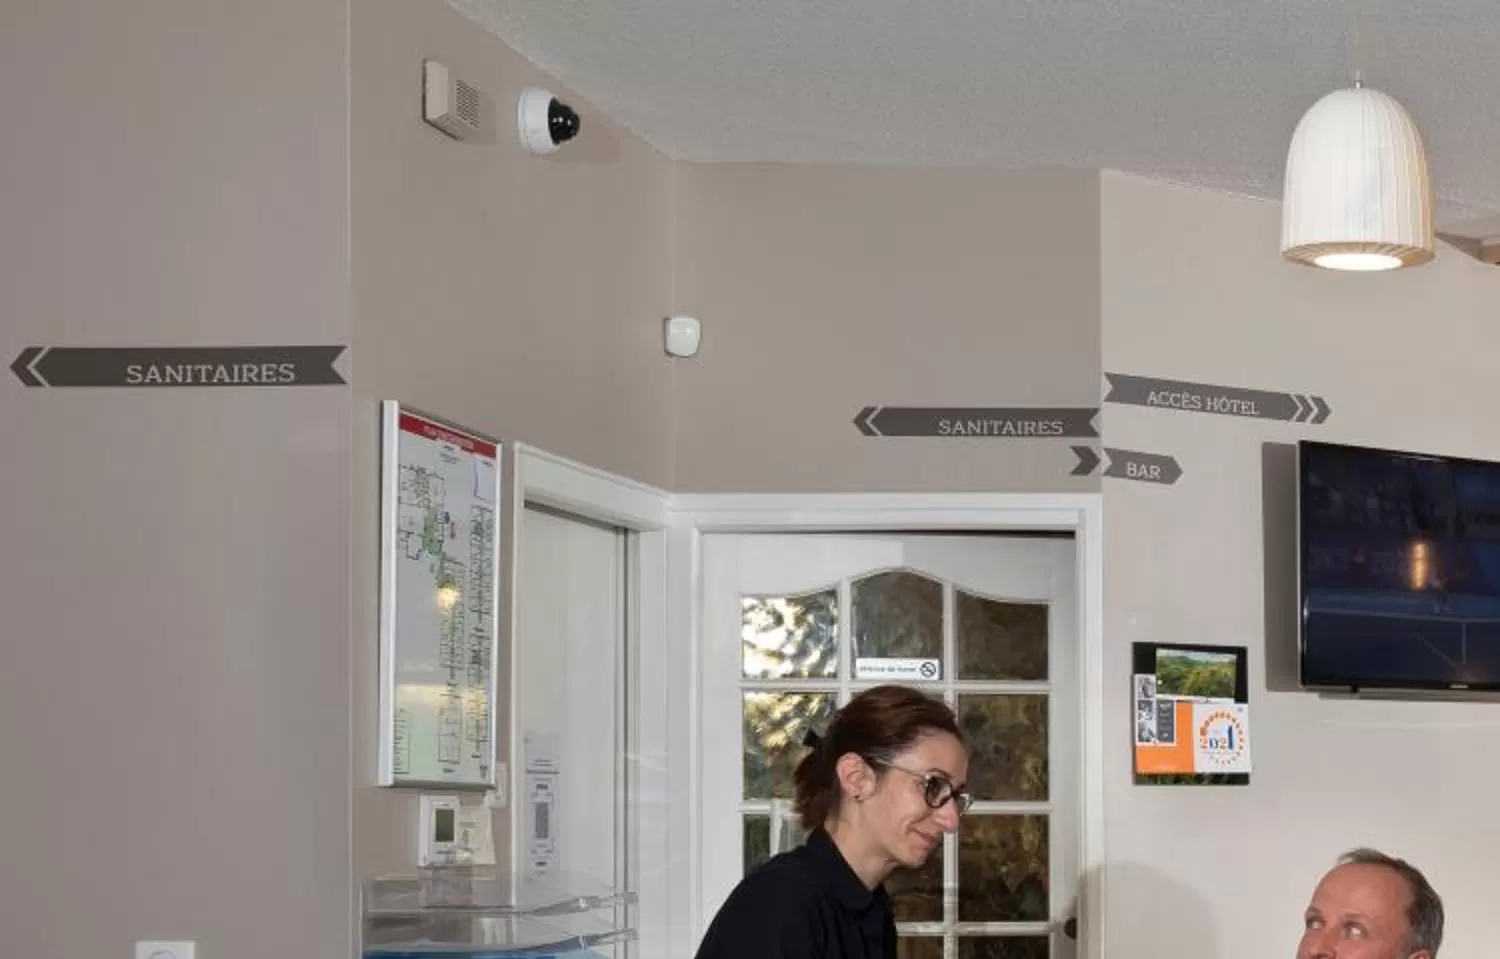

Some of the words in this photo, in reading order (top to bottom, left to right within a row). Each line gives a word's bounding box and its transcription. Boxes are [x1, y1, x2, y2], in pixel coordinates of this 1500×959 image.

[126, 363, 296, 384] SANITAIRES
[1146, 390, 1202, 410] ACCÈS
[1205, 395, 1260, 416] HÔTEL
[938, 419, 1064, 435] SANITAIRES
[1126, 462, 1161, 480] BAR
